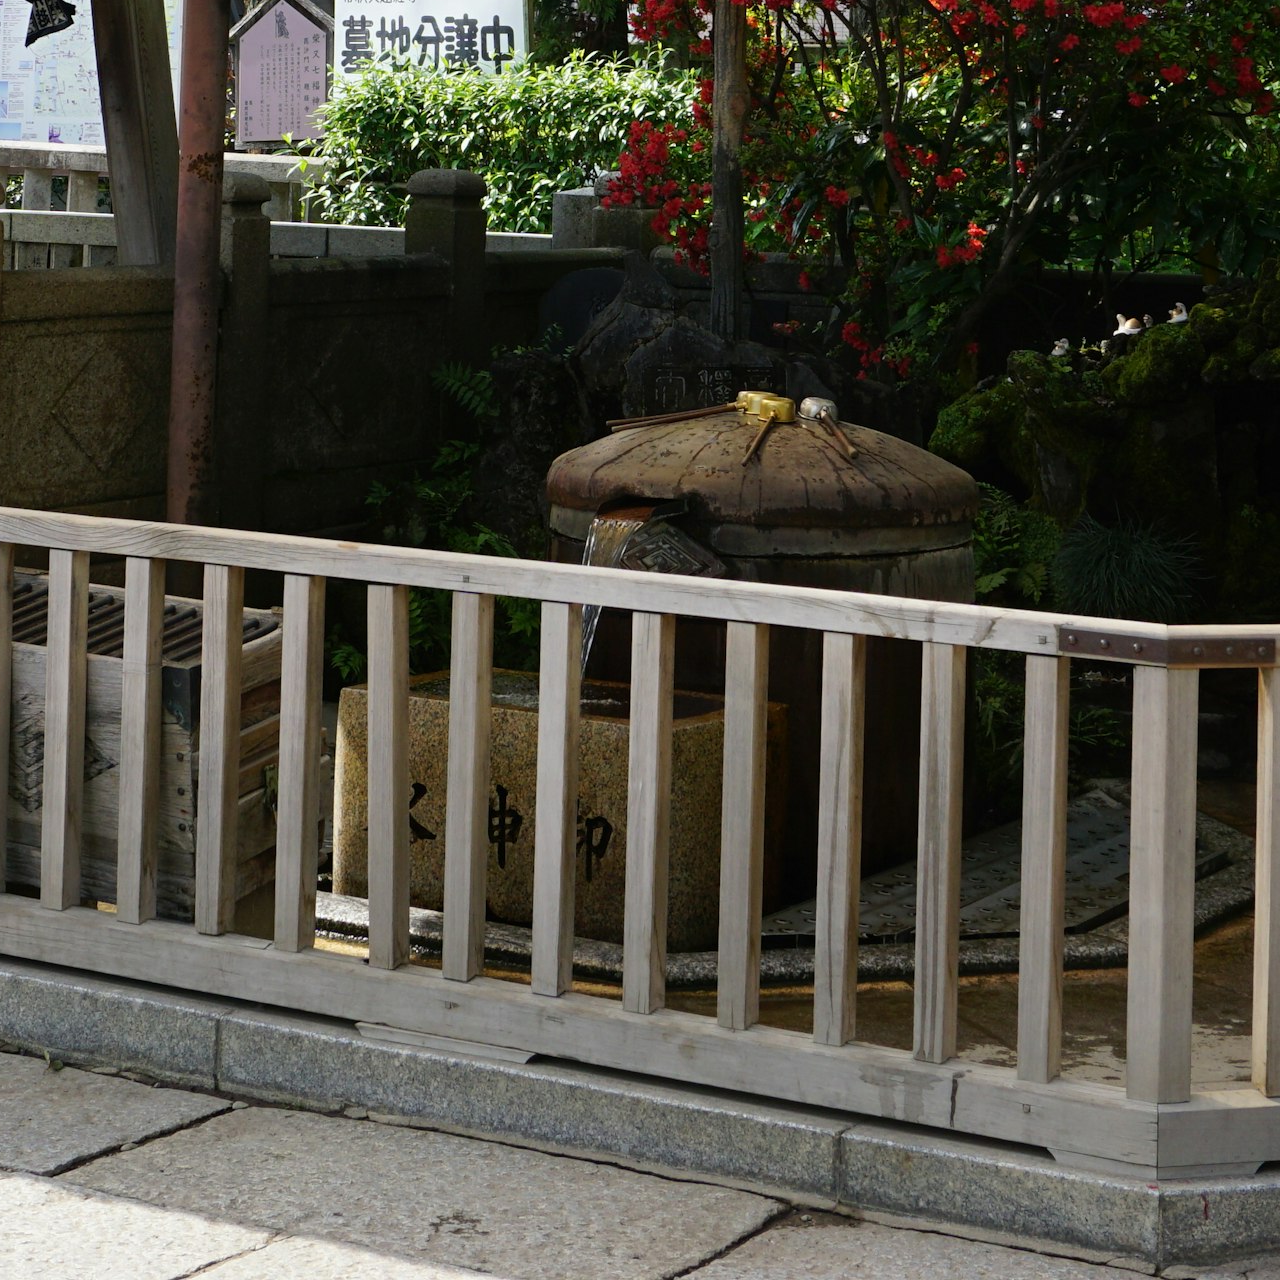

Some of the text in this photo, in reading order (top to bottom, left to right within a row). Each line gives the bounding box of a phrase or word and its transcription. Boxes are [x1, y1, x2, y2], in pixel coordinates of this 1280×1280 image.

[341, 12, 516, 76] 墓地分譲中
